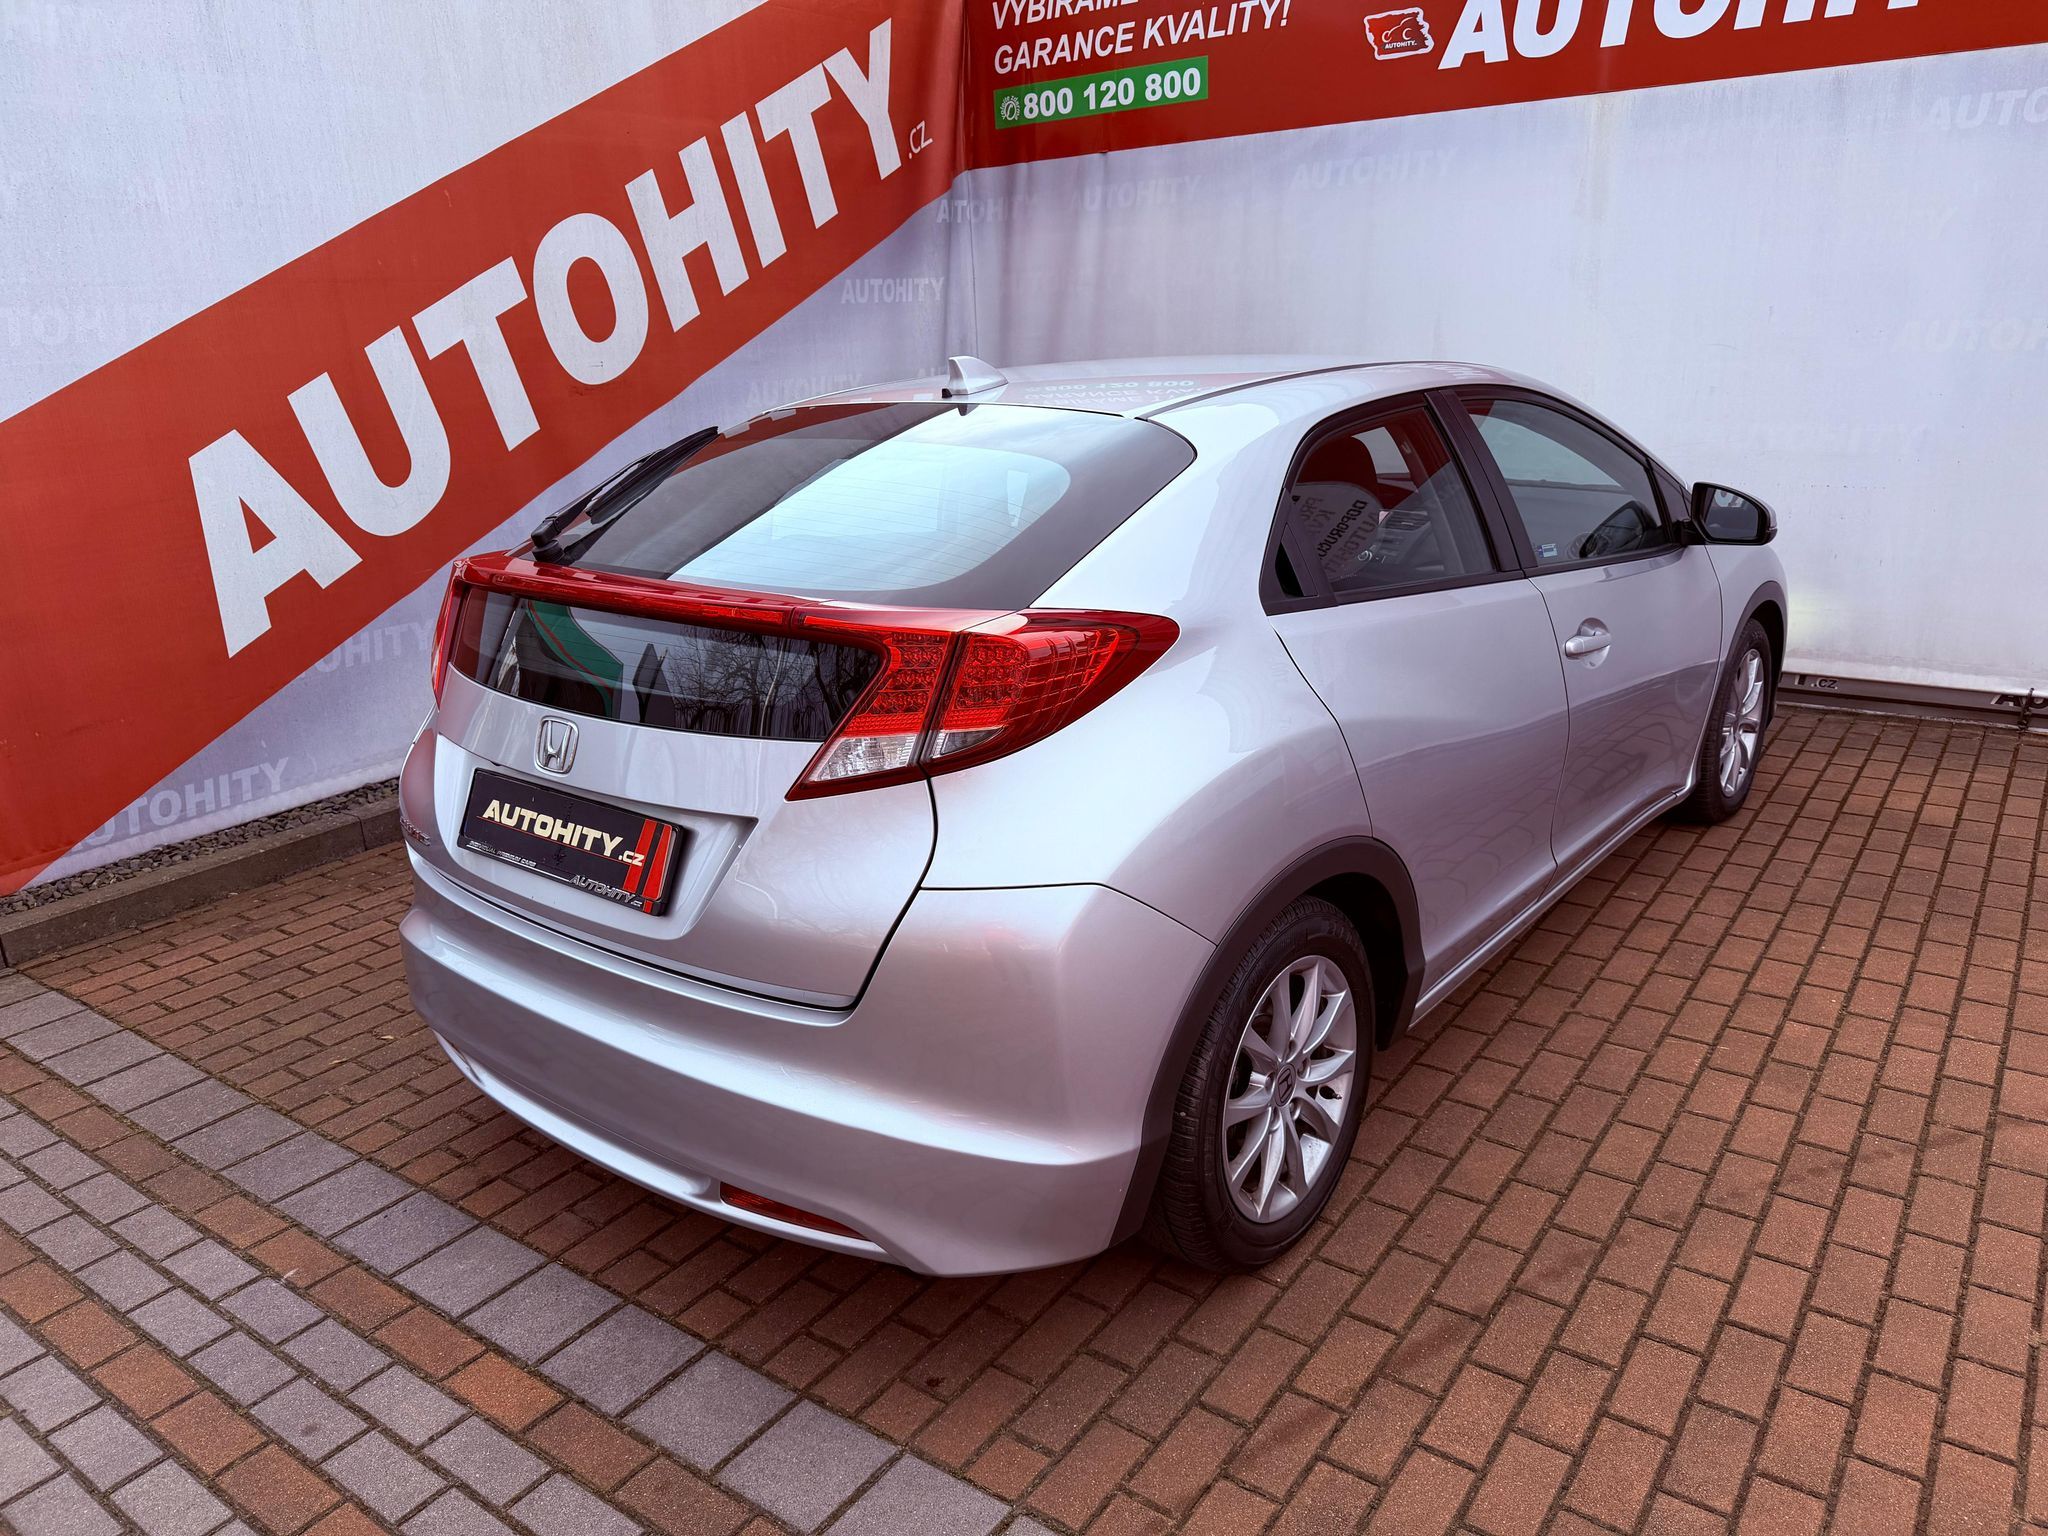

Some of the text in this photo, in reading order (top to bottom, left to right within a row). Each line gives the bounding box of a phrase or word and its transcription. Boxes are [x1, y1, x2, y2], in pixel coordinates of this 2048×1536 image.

[994, 0, 1291, 74] GARANCE KVALITY!
[1023, 67, 1201, 119] 800 120 800
[841, 276, 945, 304] AUTOHITY
